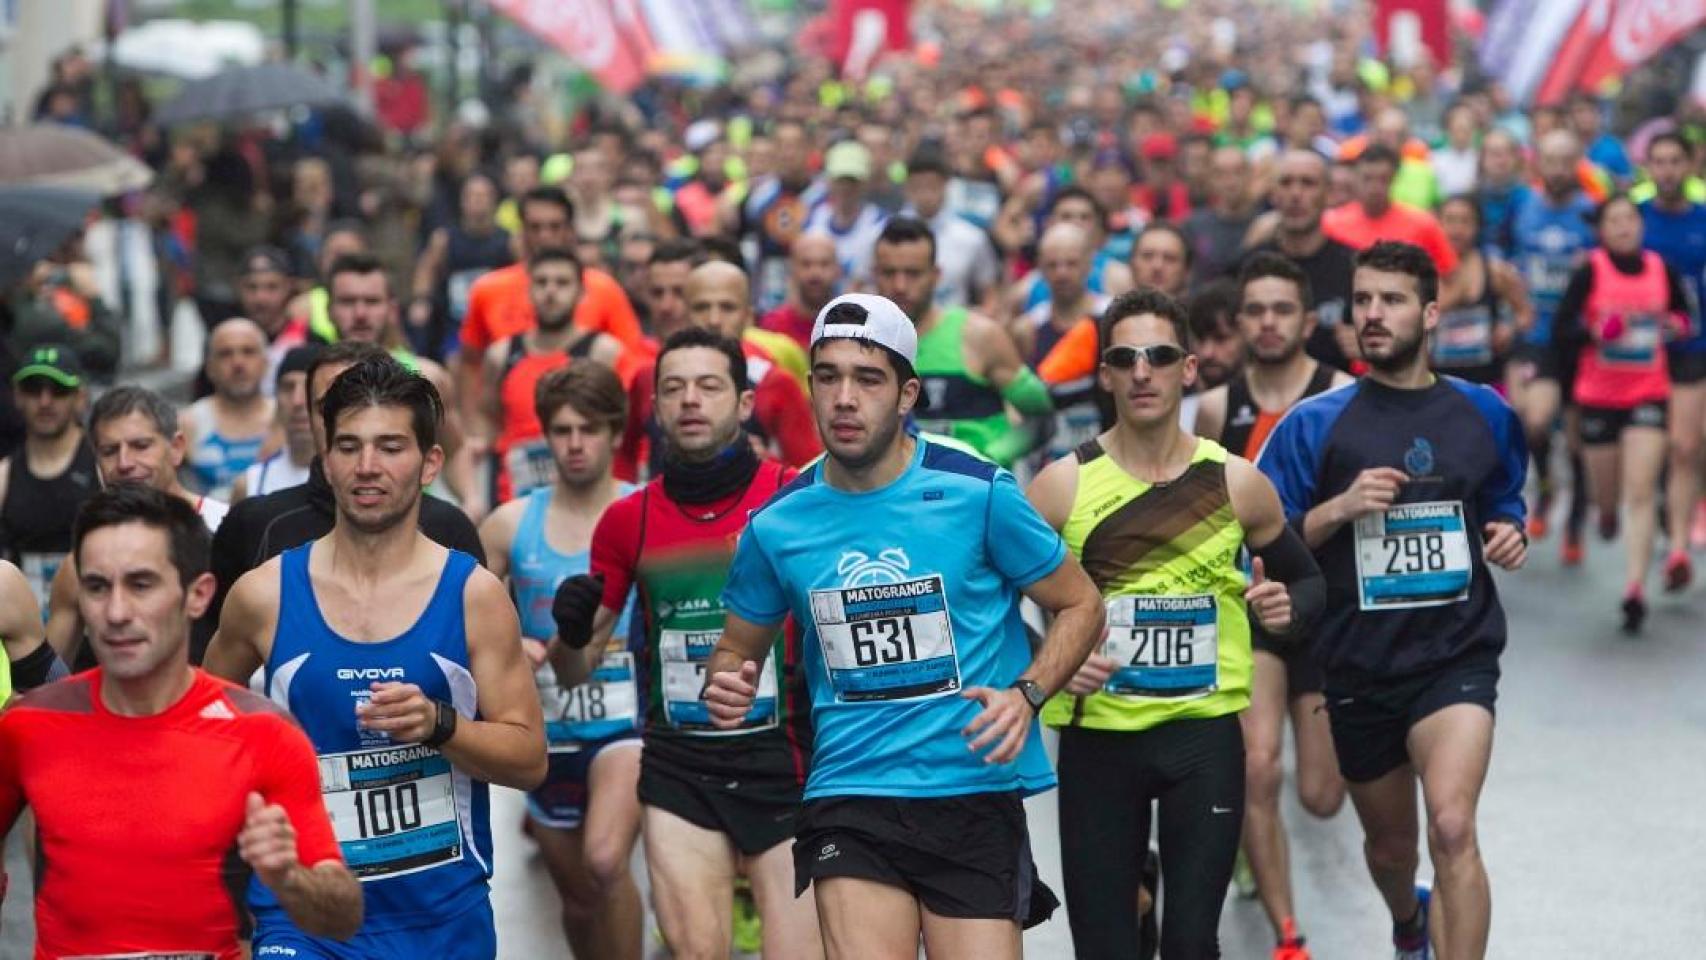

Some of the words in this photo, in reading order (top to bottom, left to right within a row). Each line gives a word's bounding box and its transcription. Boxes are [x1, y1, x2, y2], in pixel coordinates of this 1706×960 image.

[1383, 534, 1445, 574] 298
[846, 580, 934, 603] MATOGRANDE
[1137, 597, 1212, 611] MATOGRANDE
[850, 615, 917, 667] 631
[1130, 628, 1194, 667] 206
[336, 667, 404, 680] GIVOVA
[558, 684, 606, 722] 218
[354, 782, 421, 839] 100
